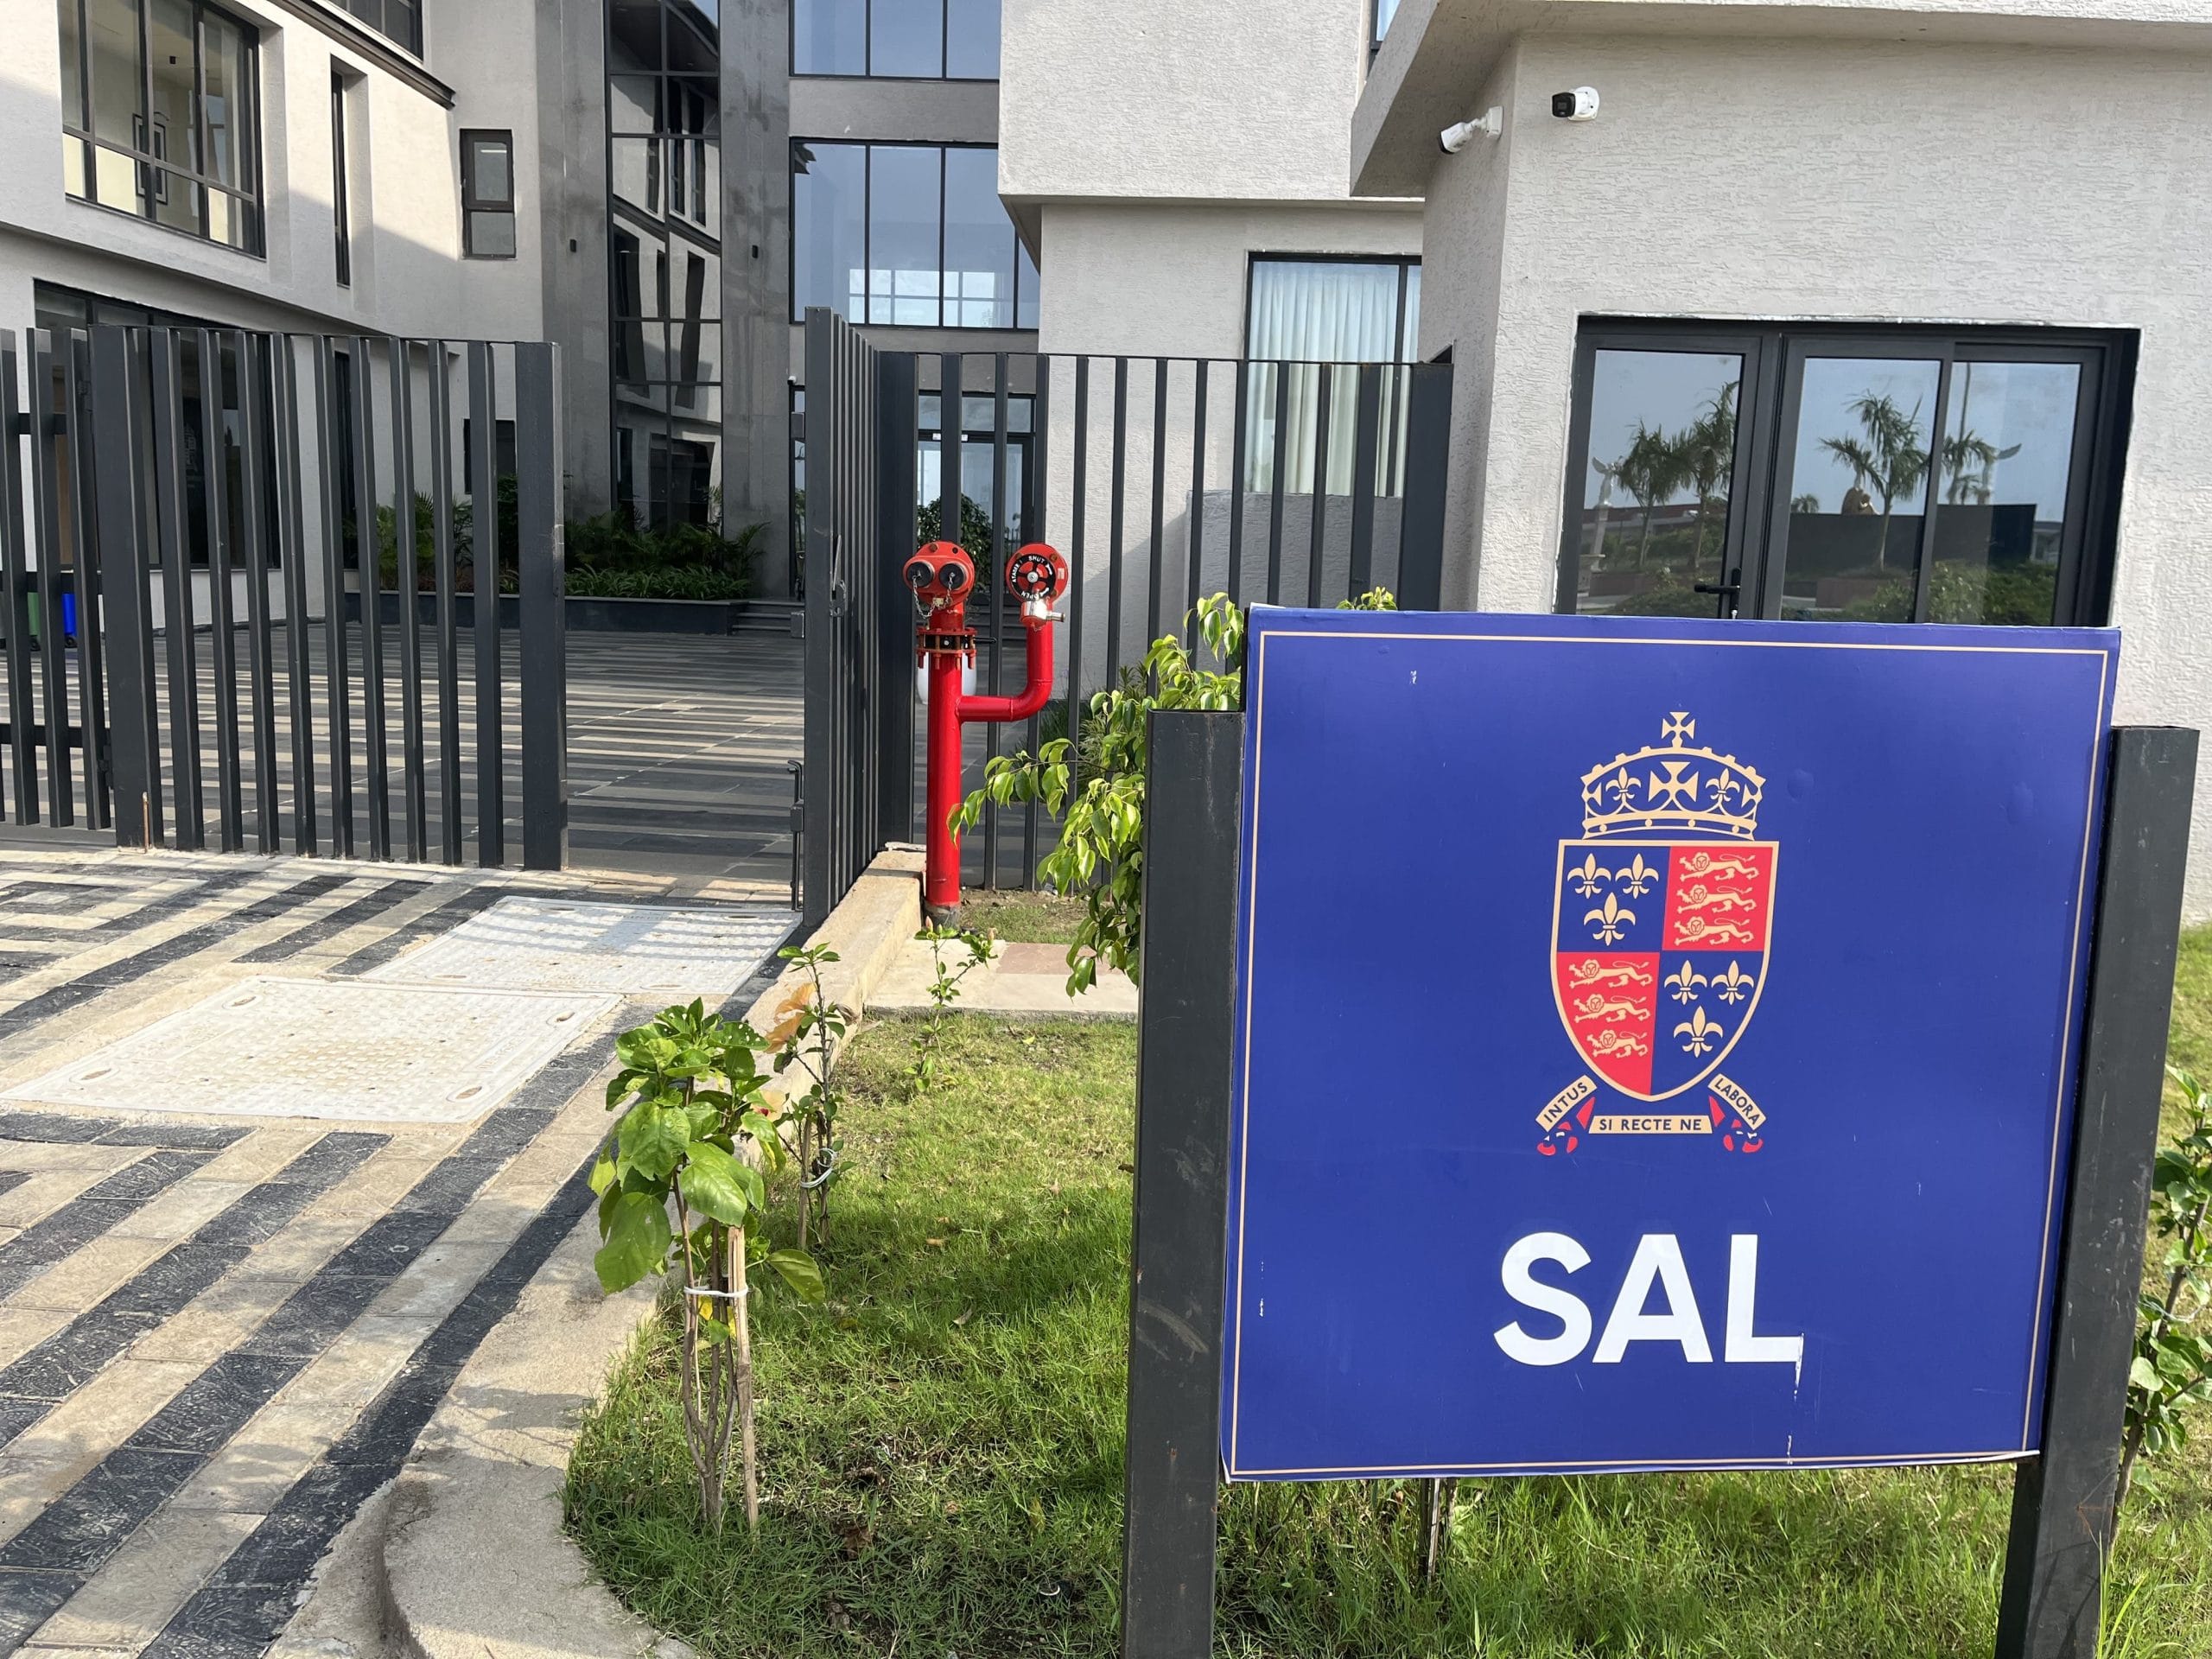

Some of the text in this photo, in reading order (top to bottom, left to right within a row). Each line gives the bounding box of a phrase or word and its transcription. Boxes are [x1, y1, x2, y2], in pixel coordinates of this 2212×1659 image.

[1543, 1077, 1761, 1131] INTUS SI RECTE NE LABORA
[1493, 1231, 1804, 1366] SAL
